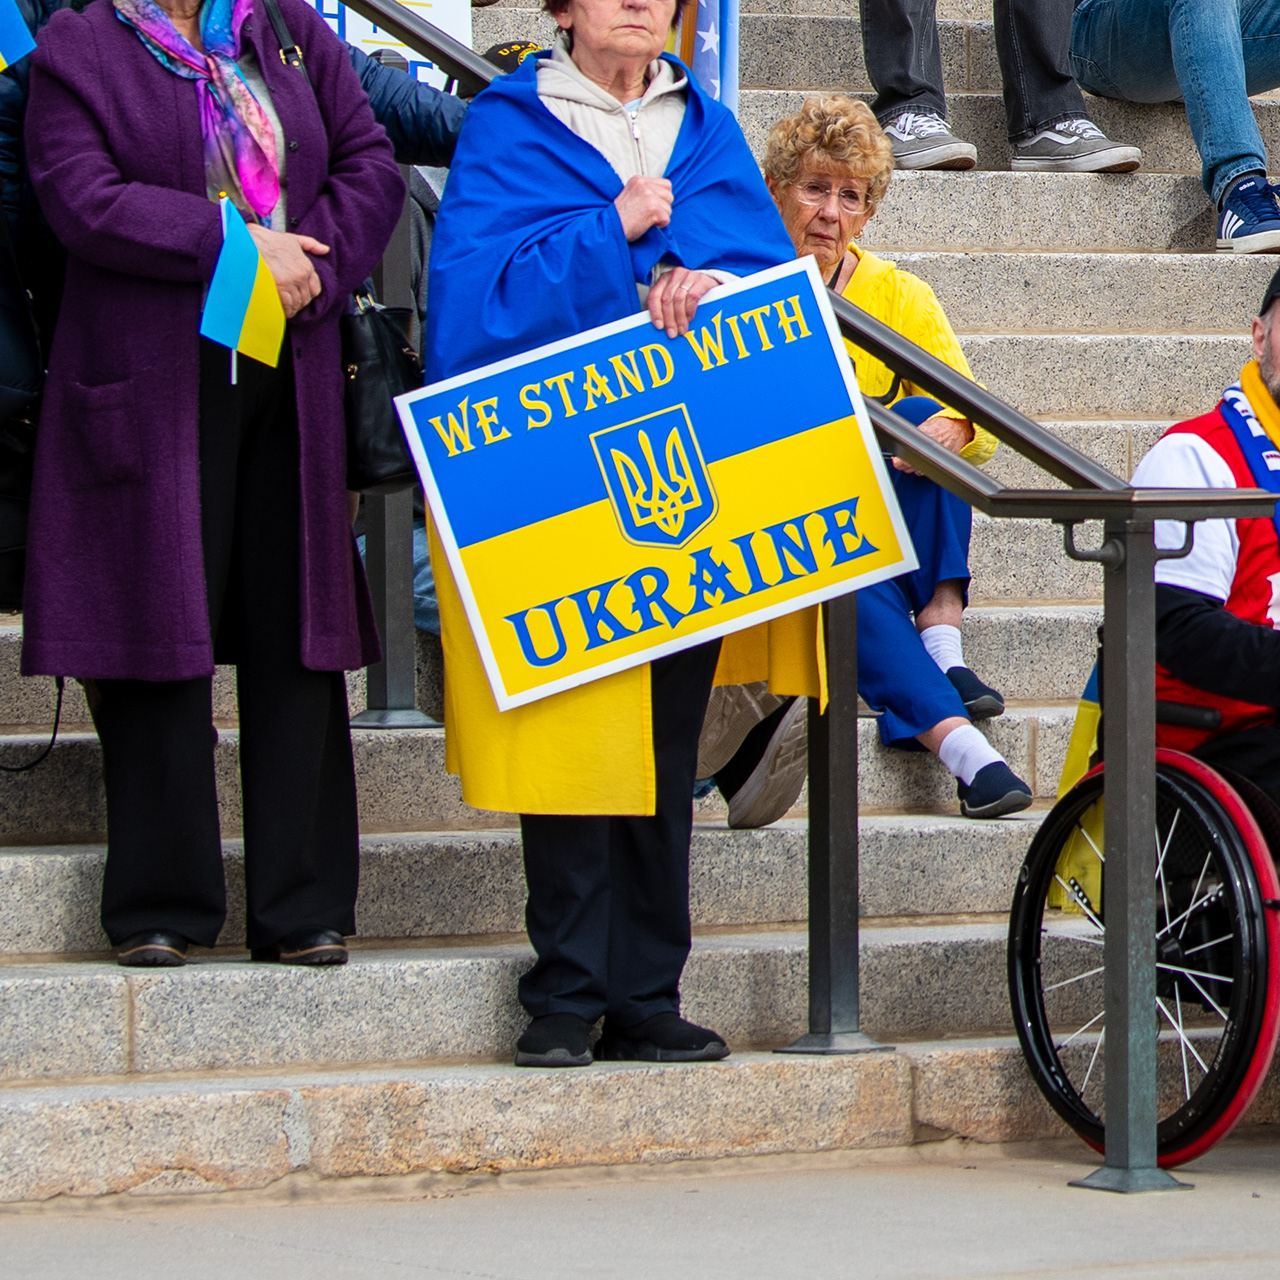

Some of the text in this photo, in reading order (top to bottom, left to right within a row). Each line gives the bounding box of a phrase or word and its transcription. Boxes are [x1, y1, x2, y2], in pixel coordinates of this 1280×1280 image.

[427, 294, 813, 459] WE STAND WITH
[502, 496, 881, 668] UKRAINE
